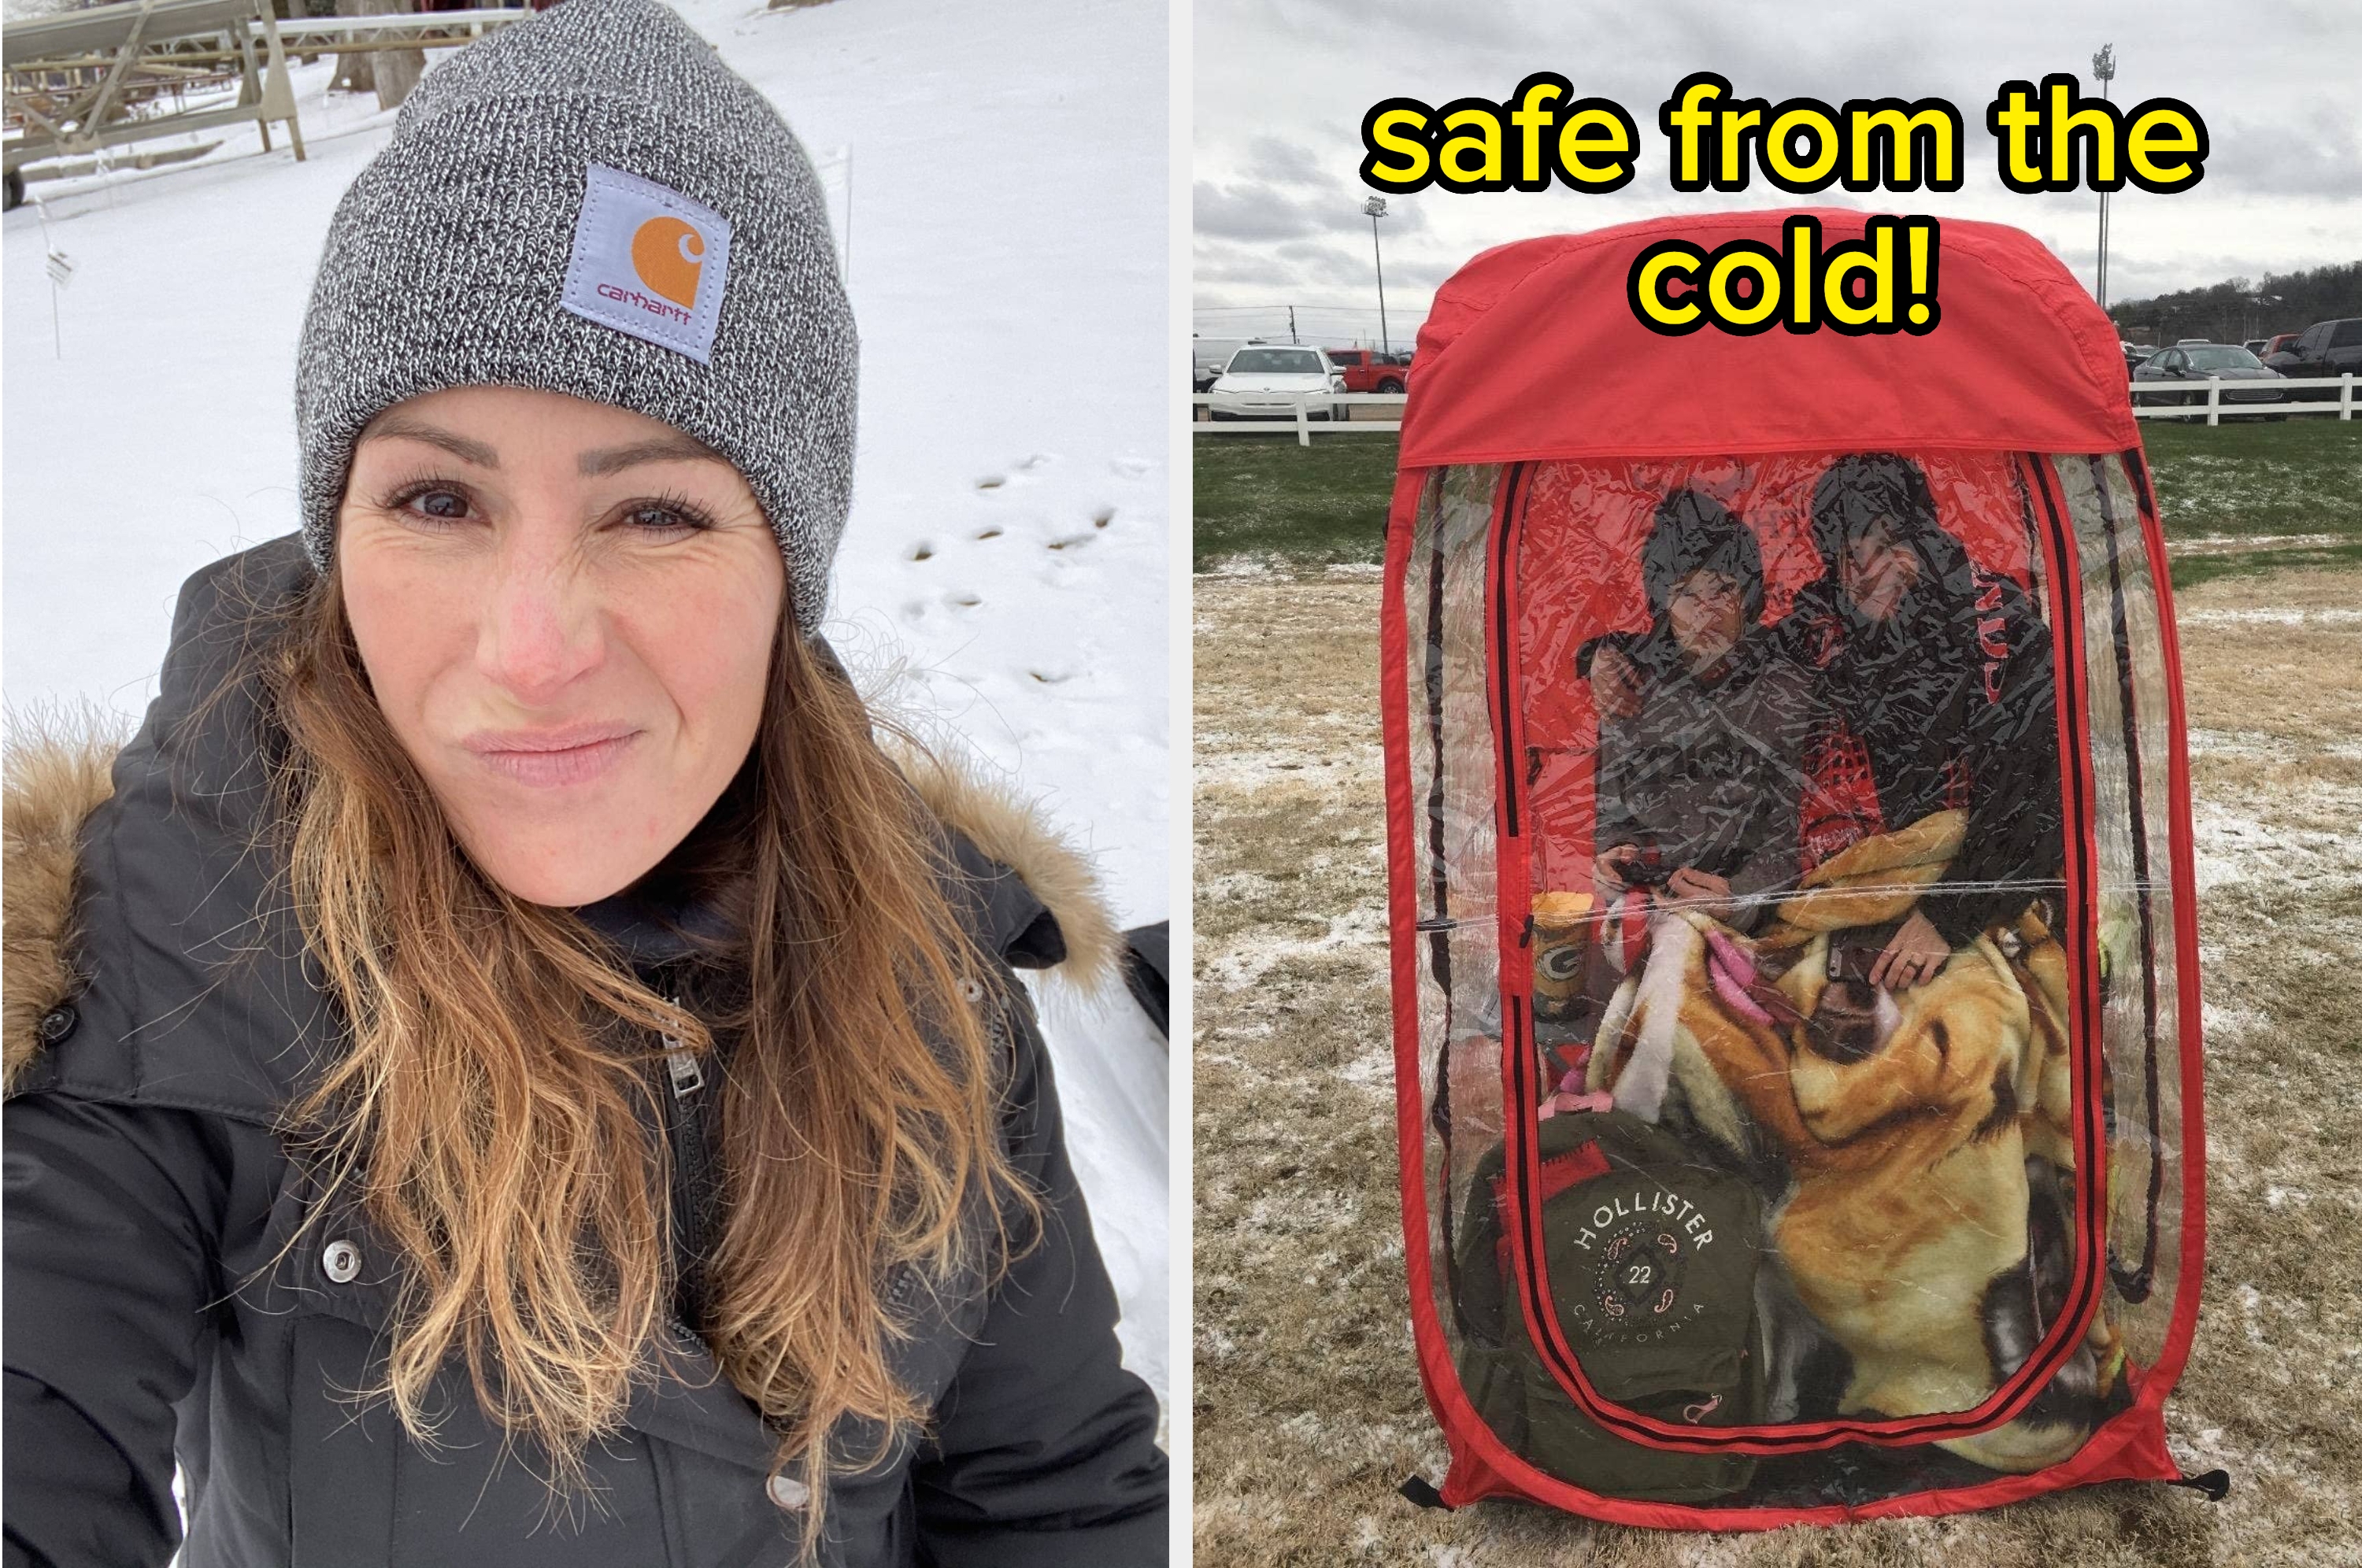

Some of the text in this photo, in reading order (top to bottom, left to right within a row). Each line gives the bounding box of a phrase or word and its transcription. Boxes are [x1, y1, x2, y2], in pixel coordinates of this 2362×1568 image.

[596, 282, 693, 326] carhartt
[1573, 1191, 1714, 1252] HOLLISTER
[1627, 1265, 1652, 1285] 22
[1574, 1303, 1705, 1343] CALIFORNIA
